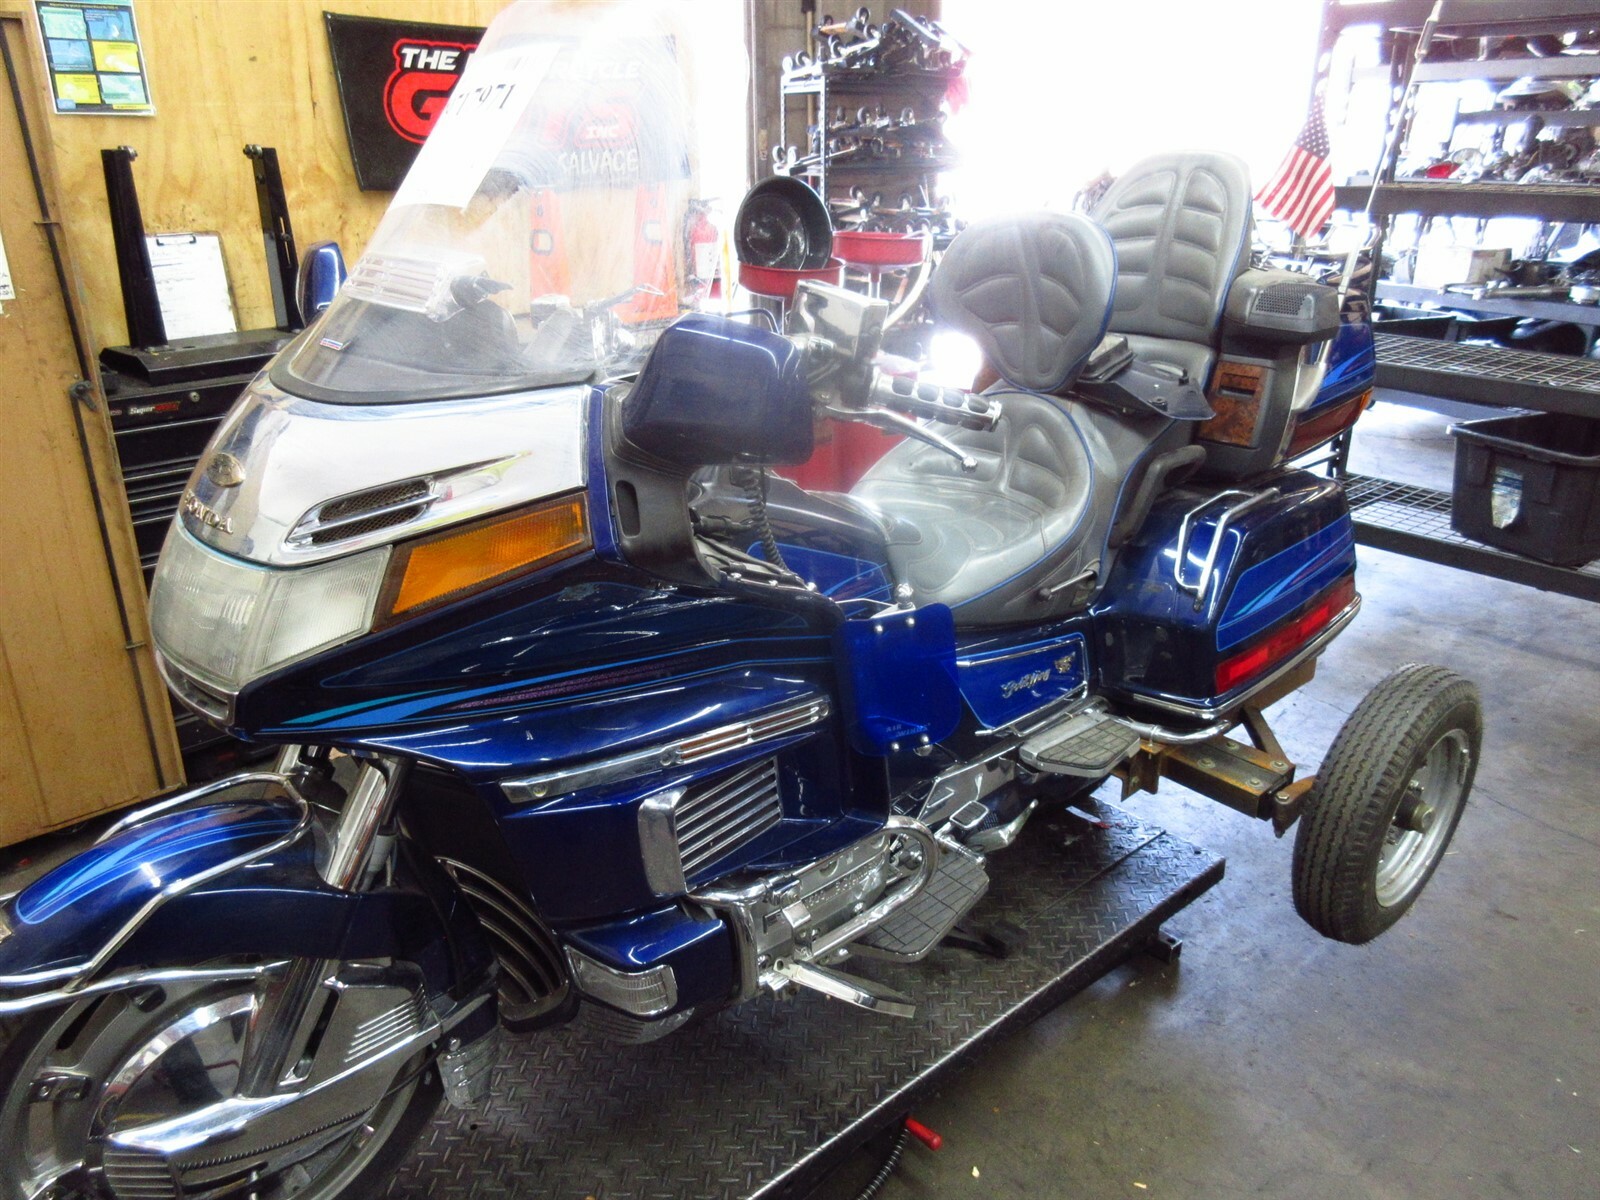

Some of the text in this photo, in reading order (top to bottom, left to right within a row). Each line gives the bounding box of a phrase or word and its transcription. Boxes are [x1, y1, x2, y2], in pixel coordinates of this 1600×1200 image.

[401, 46, 460, 71] THE
[585, 126, 619, 140] INC
[557, 149, 639, 177] SALVAGE
